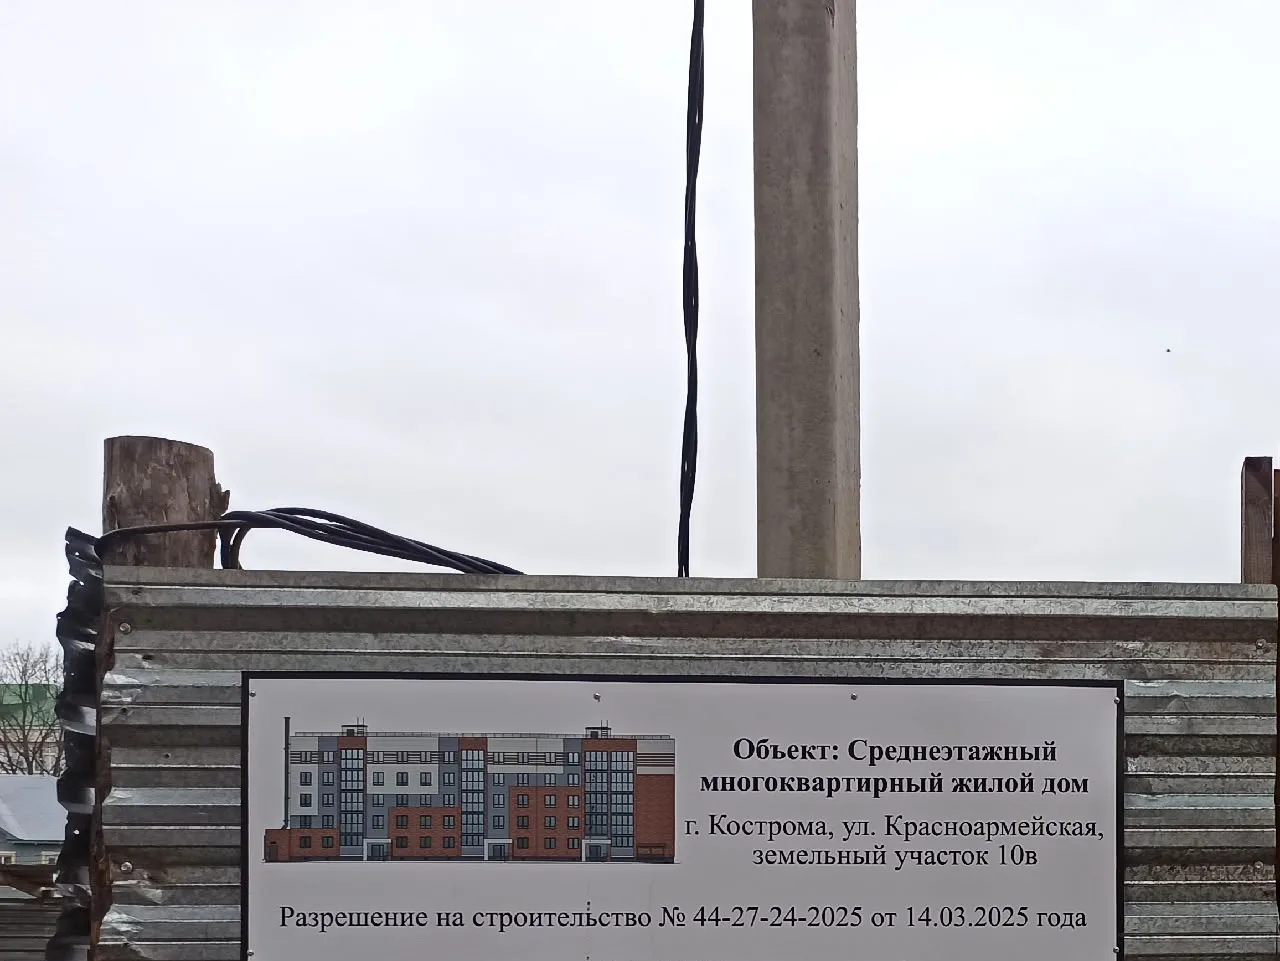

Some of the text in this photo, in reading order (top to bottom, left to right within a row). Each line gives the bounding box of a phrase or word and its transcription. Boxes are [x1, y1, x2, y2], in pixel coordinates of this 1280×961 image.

[733, 737, 1057, 767] Объект: Среднеэтажный
[699, 771, 1089, 799] многоквартирный жилой дом
[684, 814, 1104, 842] г. Кострома, ул. Красноармейская,
[752, 844, 1038, 871] земельный участок 10в
[279, 905, 1088, 933] Разрешение на строительство № 44-27-24-2025 от 14.03.2025 года
